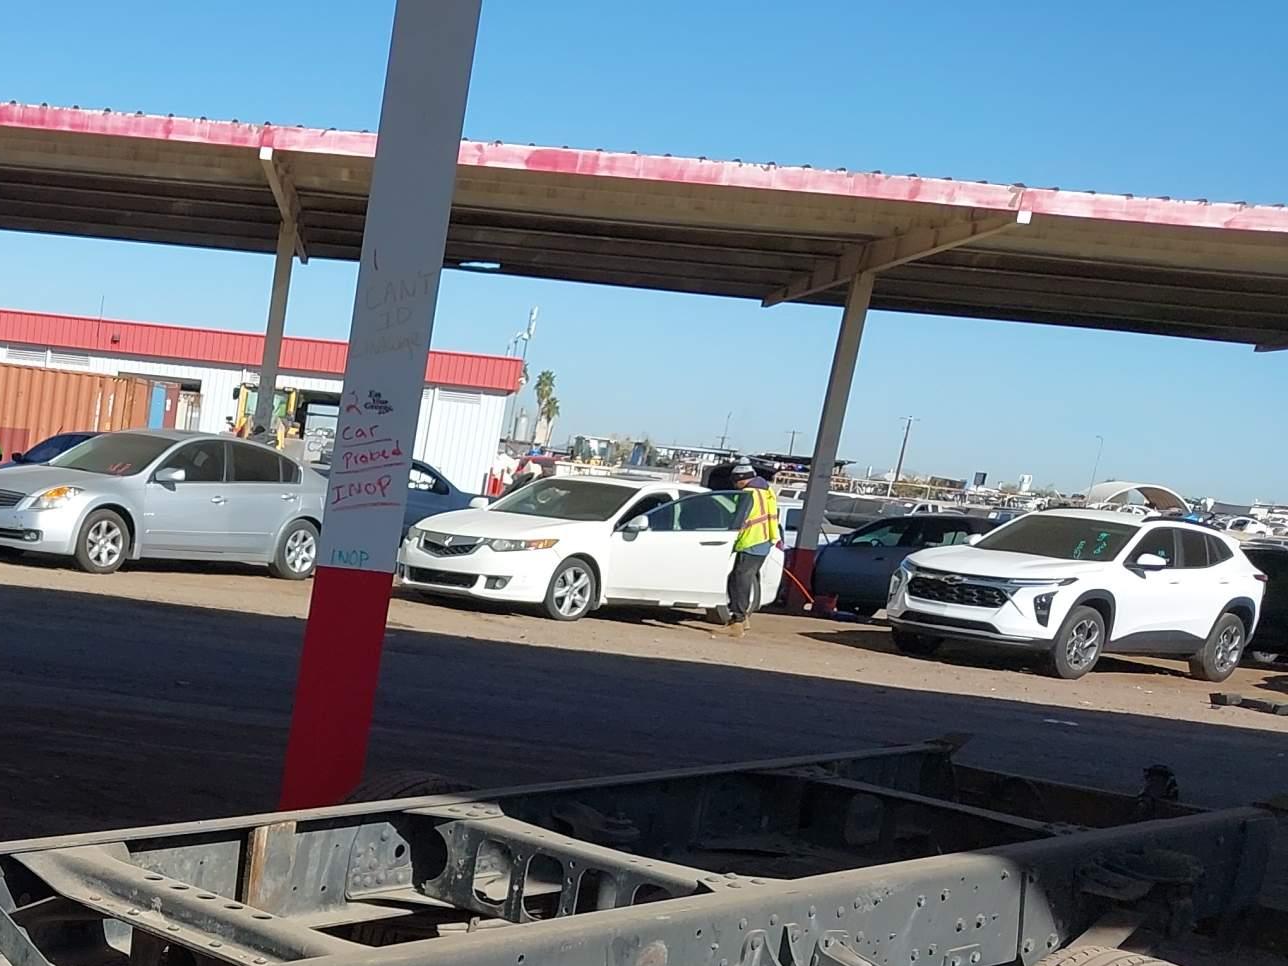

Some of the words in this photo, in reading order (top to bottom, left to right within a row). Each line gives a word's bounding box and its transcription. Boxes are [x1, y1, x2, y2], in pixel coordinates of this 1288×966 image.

[345, 390, 362, 416] 2
[331, 474, 393, 505] INOP
[330, 547, 370, 567] INOP
